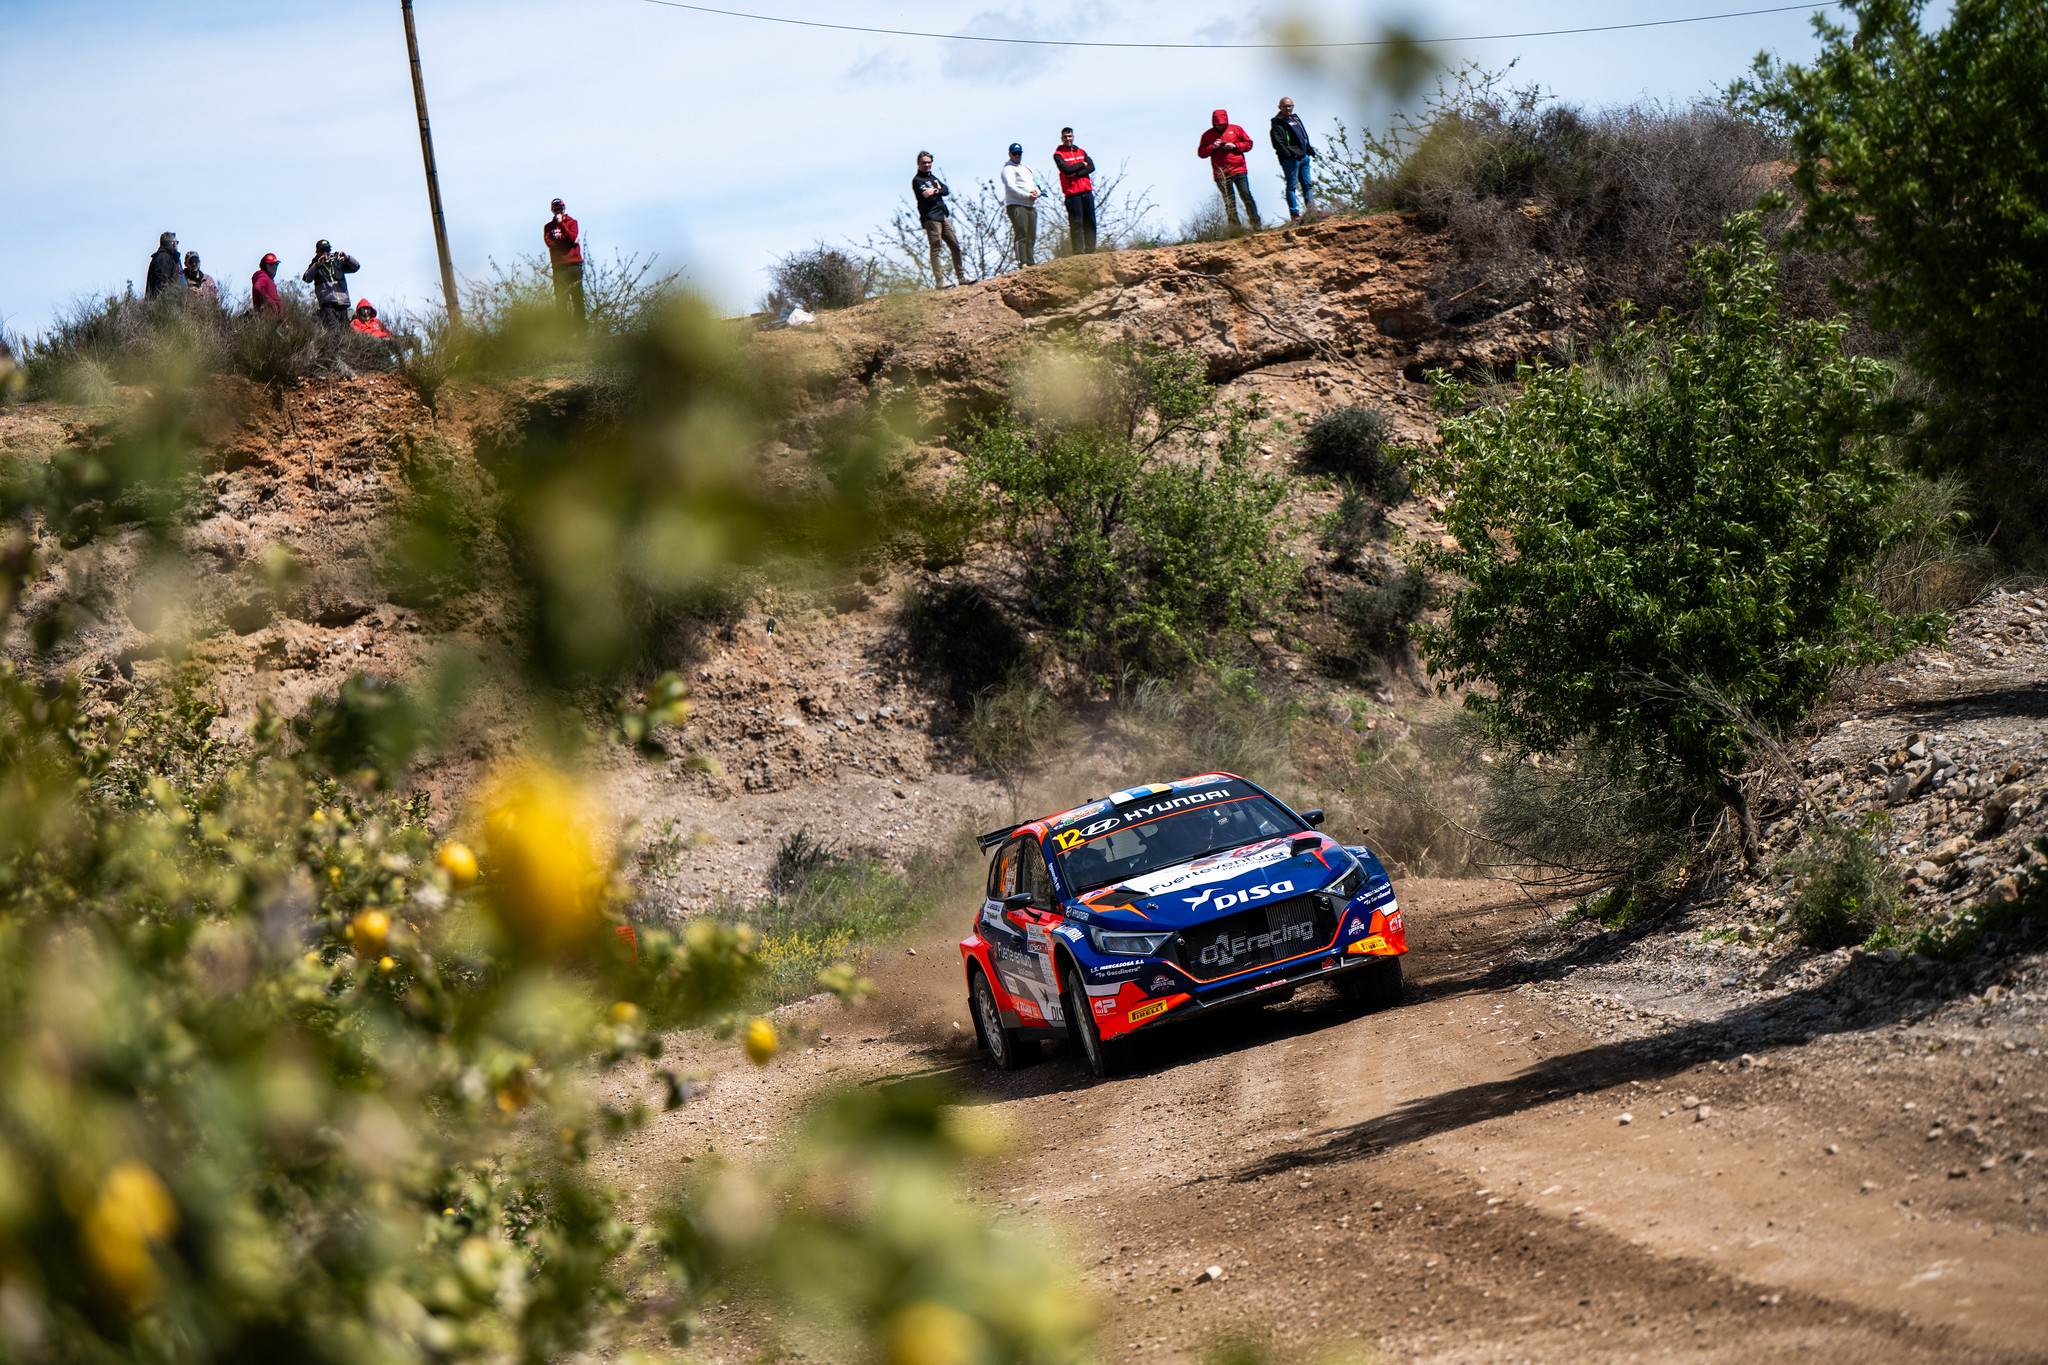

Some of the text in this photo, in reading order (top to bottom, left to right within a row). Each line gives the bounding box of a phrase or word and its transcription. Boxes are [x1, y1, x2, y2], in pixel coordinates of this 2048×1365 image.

[1123, 789, 1231, 821] HYUNDAI
[1056, 828, 1086, 850] 12
[1000, 856, 1009, 892] 12
[1148, 850, 1285, 893] Fuerteventura
[1213, 880, 1295, 911] DISA
[1131, 1001, 1164, 1021] PIRELLI
